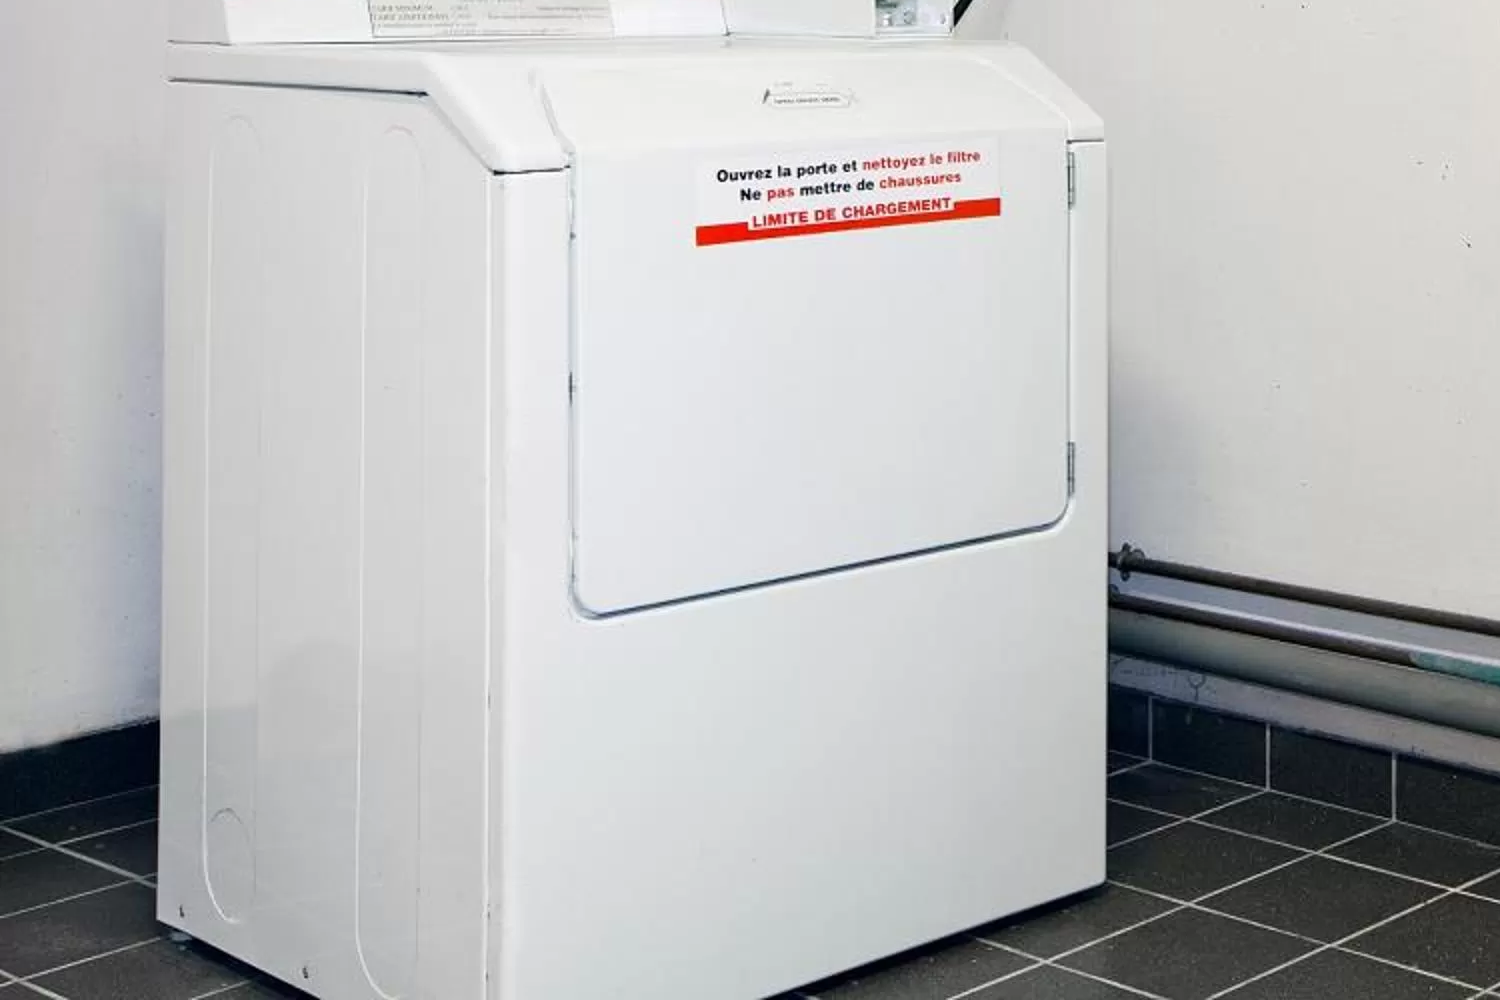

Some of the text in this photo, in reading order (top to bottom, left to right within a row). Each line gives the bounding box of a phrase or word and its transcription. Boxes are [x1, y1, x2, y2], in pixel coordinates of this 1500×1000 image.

[717, 150, 981, 183] Ouvrez la porte et nettoyez le filtre
[740, 172, 961, 202] Ne pas mettre de chaussures
[752, 197, 952, 228] LIMITE DE CHARGEMENT
